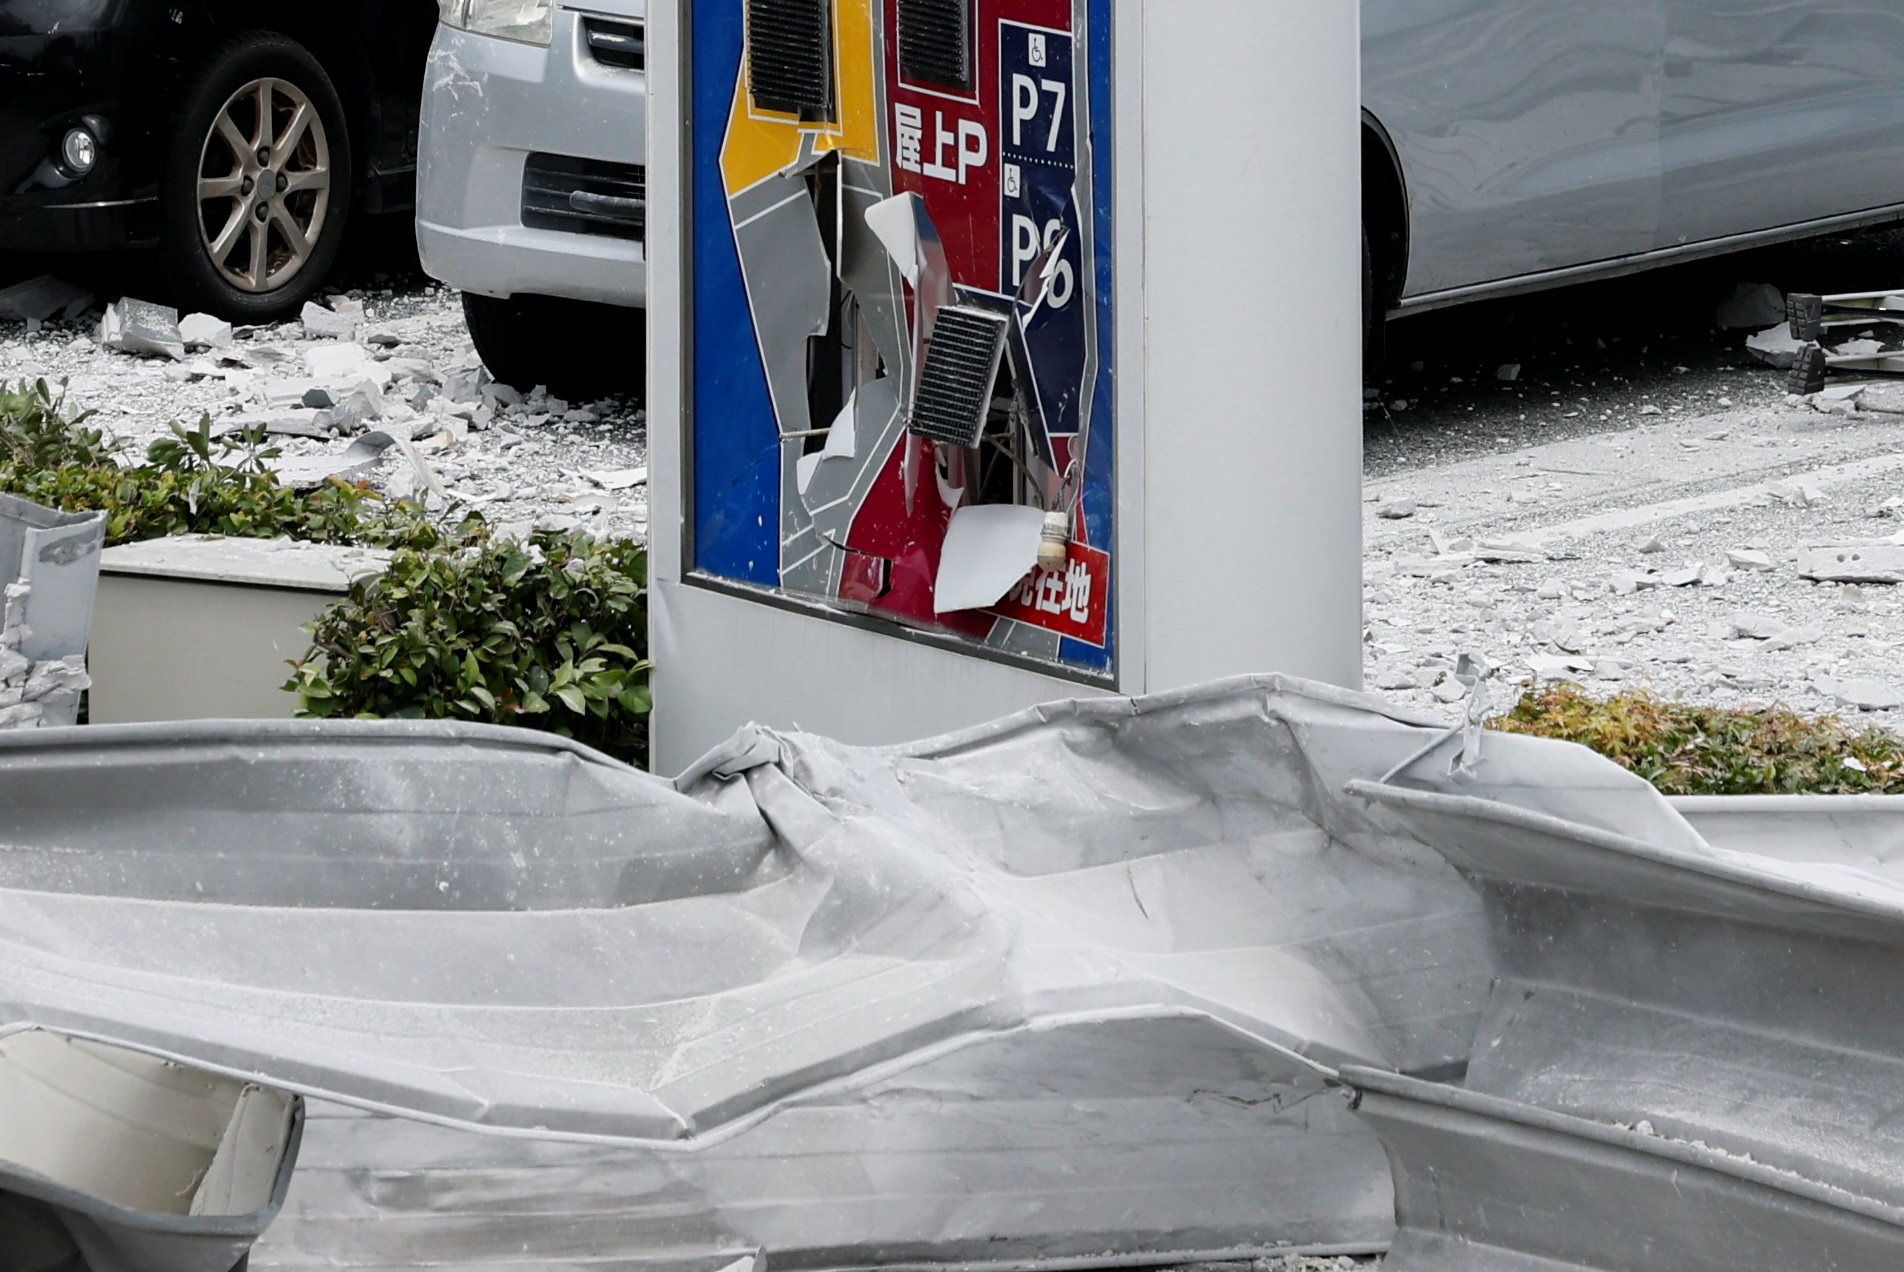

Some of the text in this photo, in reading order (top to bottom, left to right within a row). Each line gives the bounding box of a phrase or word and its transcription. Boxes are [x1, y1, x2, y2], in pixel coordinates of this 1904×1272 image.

[894, 102, 988, 185] 屋上P
[1012, 73, 1066, 152] P7
[1012, 213, 1074, 309] P6
